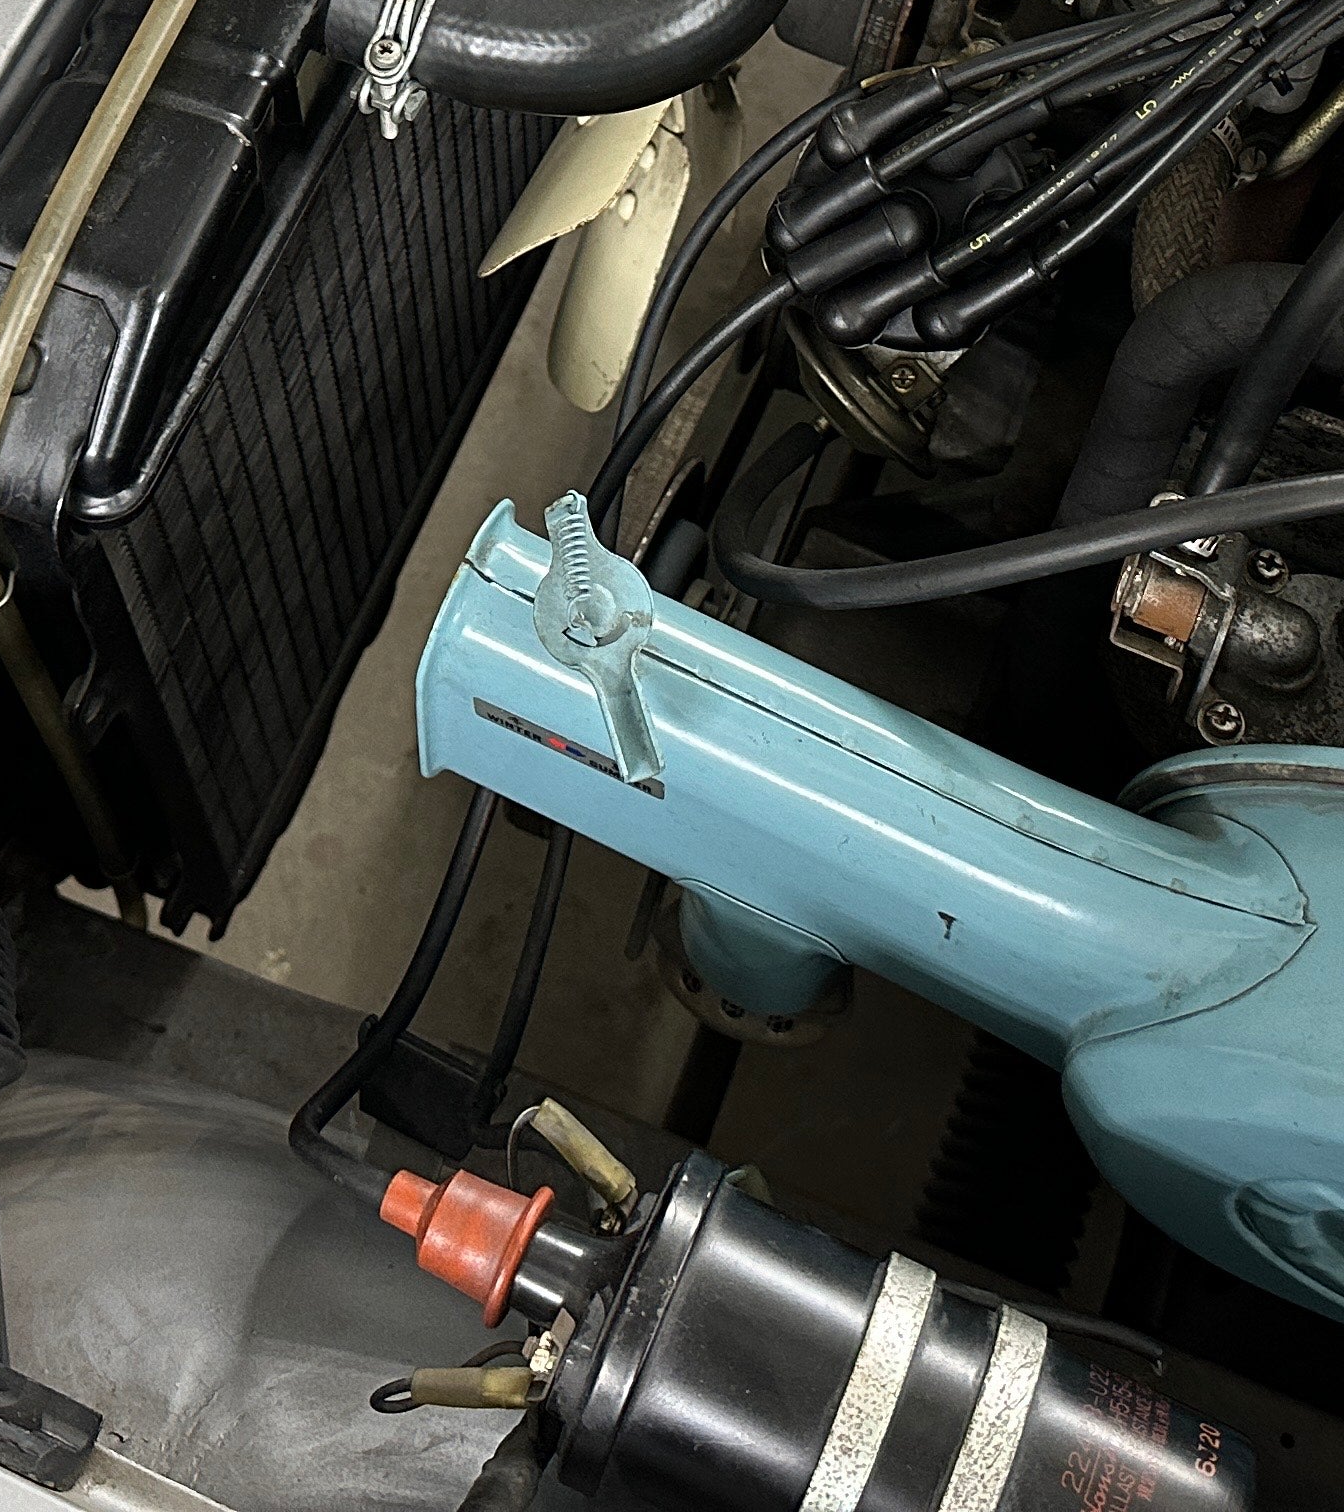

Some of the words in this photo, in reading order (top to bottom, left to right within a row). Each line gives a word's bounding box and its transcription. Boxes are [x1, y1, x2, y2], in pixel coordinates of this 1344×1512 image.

[969, 232, 991, 250] 5
[1003, 171, 1075, 227] SUMITOMO
[1086, 133, 1118, 163] 1977
[1135, 99, 1157, 120] 5
[486, 712, 543, 743] WINTER
[588, 758, 653, 795] SUMER
[1195, 1422, 1221, 1478] 6J20
